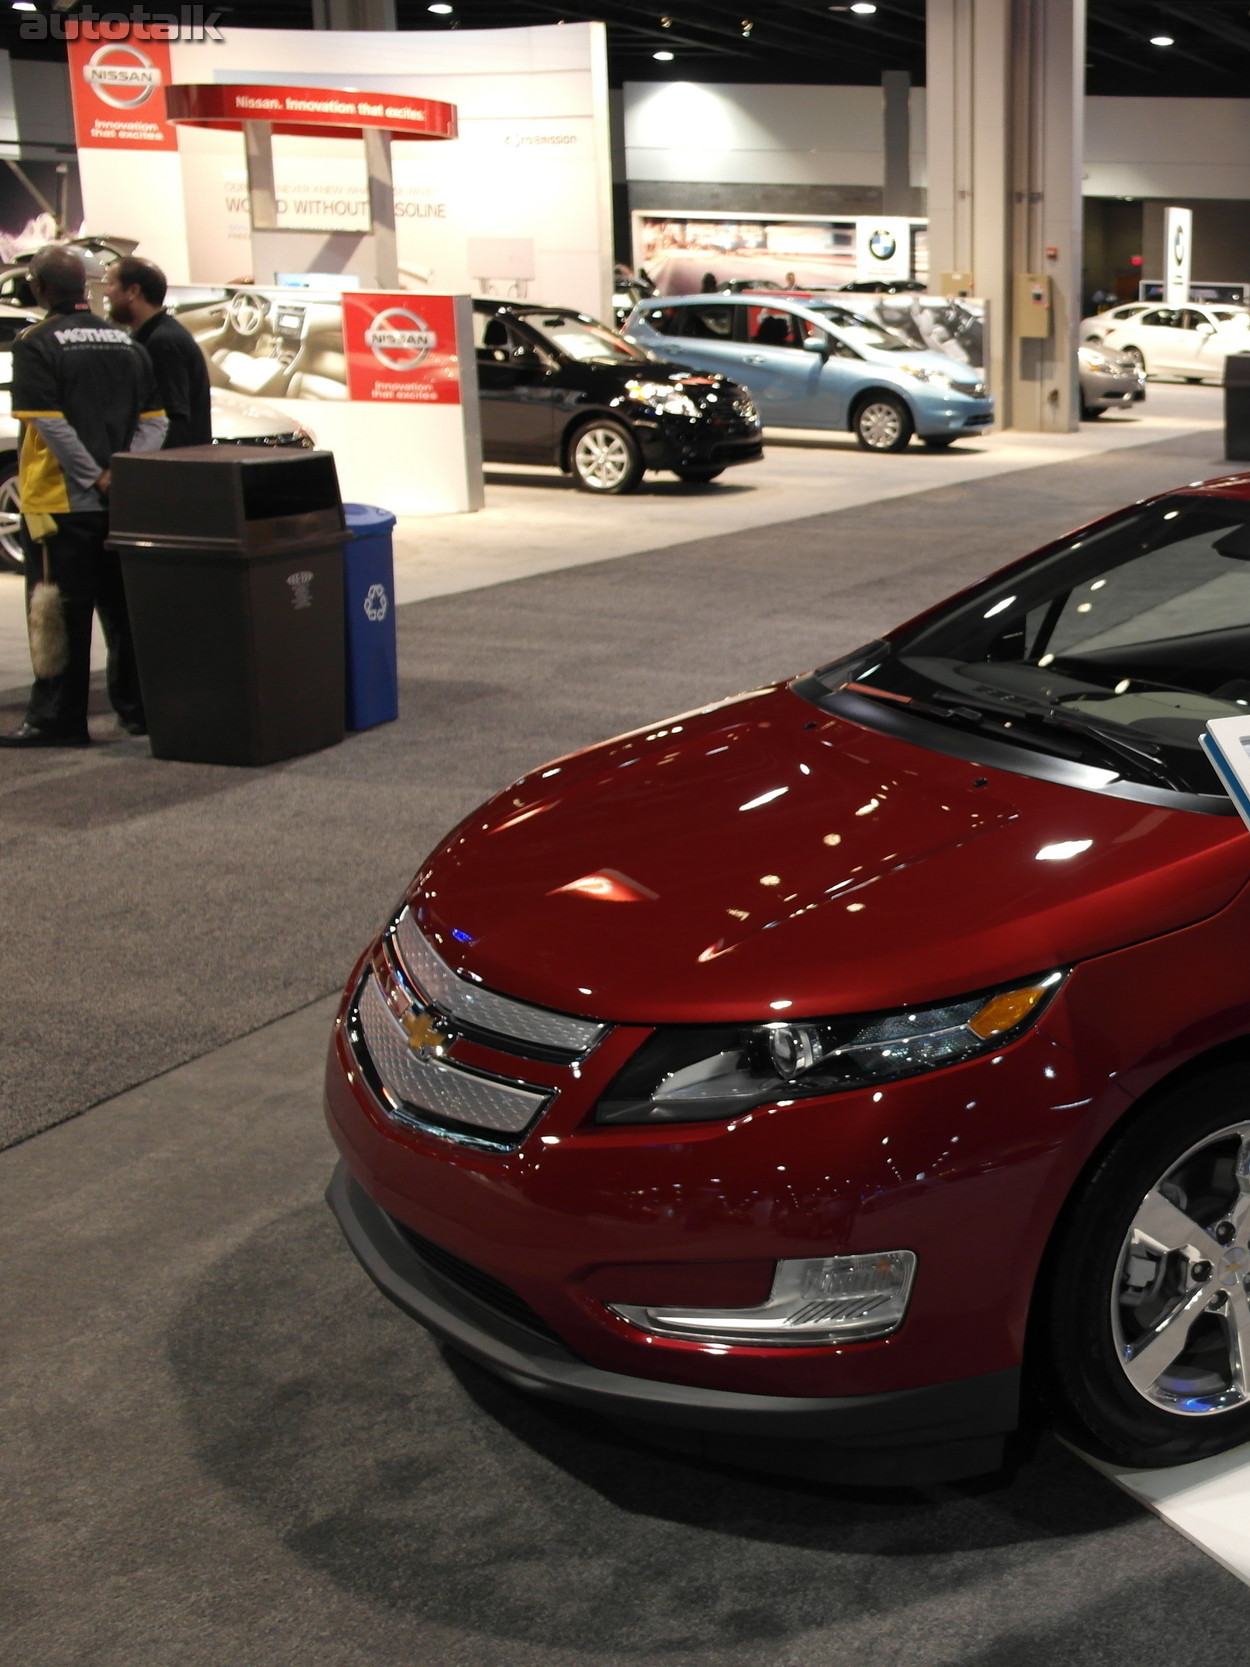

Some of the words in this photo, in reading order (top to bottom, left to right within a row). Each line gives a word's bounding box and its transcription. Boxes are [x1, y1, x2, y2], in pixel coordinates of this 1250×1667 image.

[91, 69, 152, 82] NISSAN
[236, 96, 282, 110] Nissan.
[286, 98, 356, 114] Innovation
[357, 103, 384, 116] that
[385, 107, 426, 121] excites.
[95, 119, 158, 131] Innovation
[91, 128, 116, 139] that
[118, 130, 163, 141] excites
[226, 198, 288, 214] WOD
[294, 200, 370, 217] WITHOUT
[375, 382, 434, 392] Innovation
[372, 390, 393, 399] that
